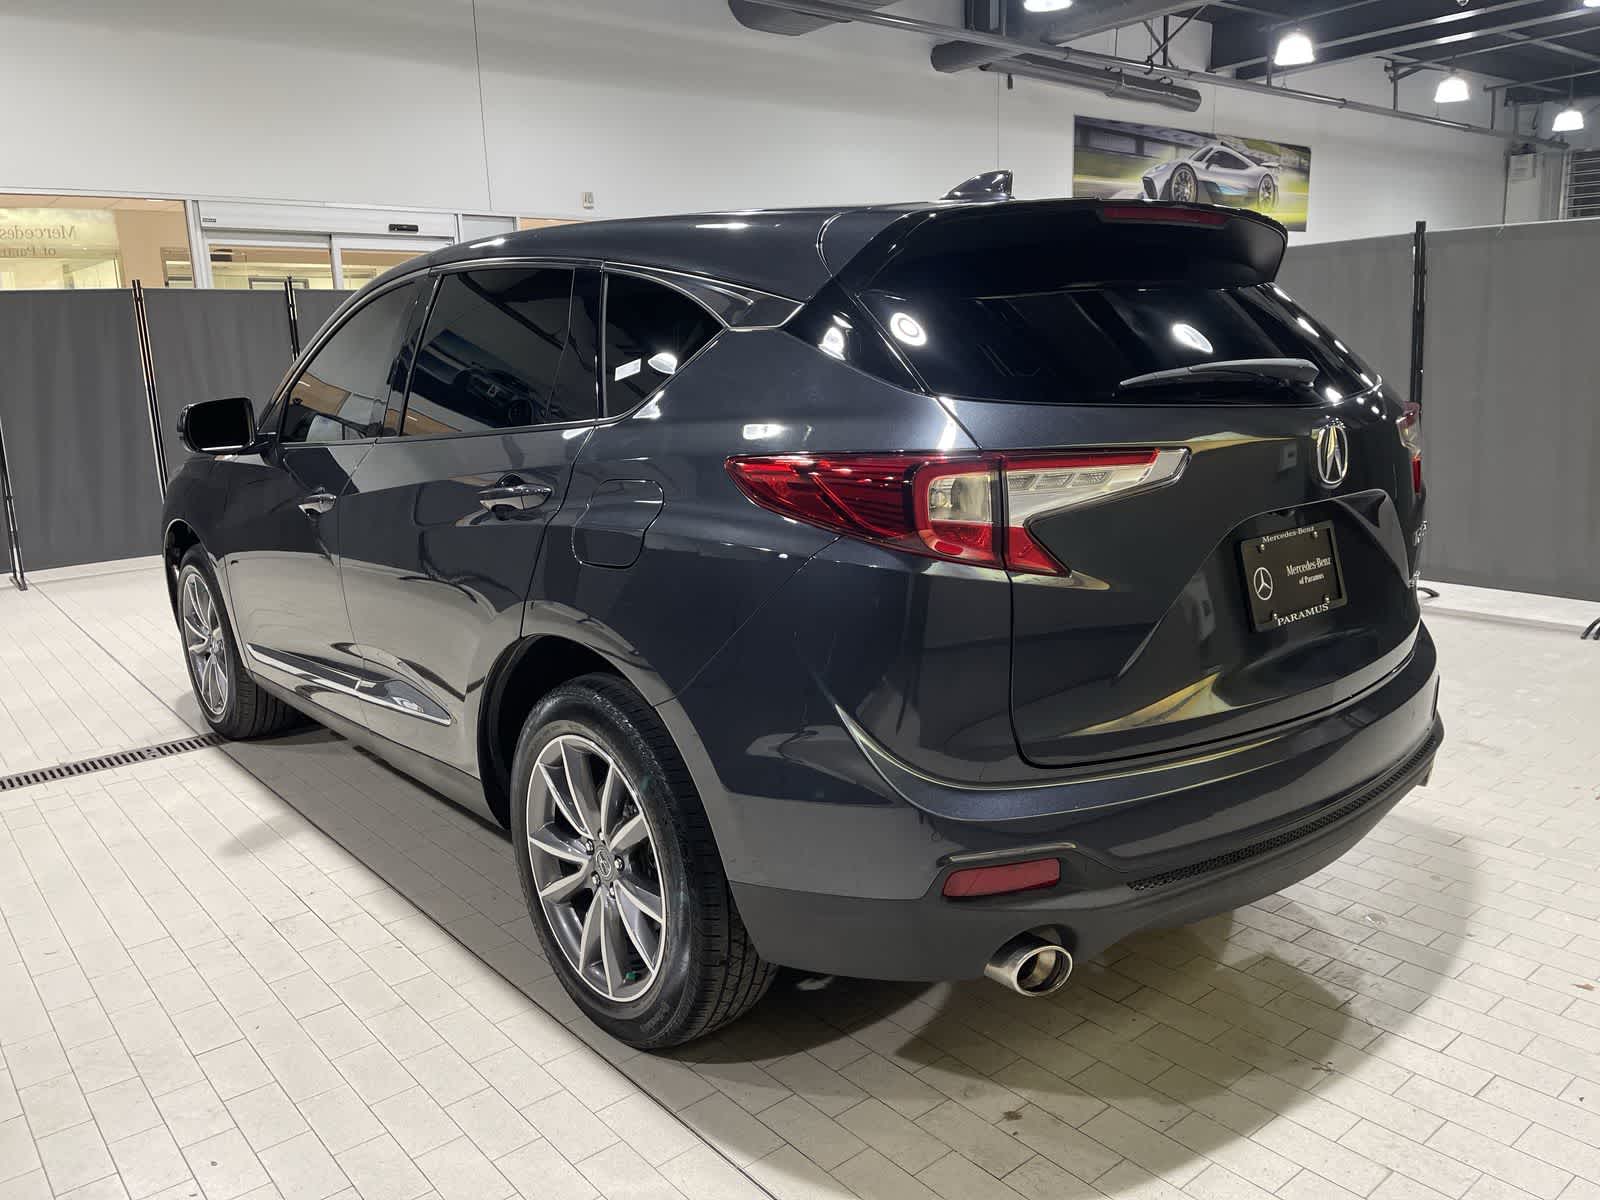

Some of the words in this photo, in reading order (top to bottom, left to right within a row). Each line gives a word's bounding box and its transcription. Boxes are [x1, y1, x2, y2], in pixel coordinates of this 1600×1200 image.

[1262, 526, 1315, 543] Mercedes-Benz
[1286, 557, 1331, 577] Mercedes-Benz
[1299, 576, 1305, 584] of
[1305, 573, 1325, 583] Paramus
[1277, 603, 1329, 626] PARAMUS
